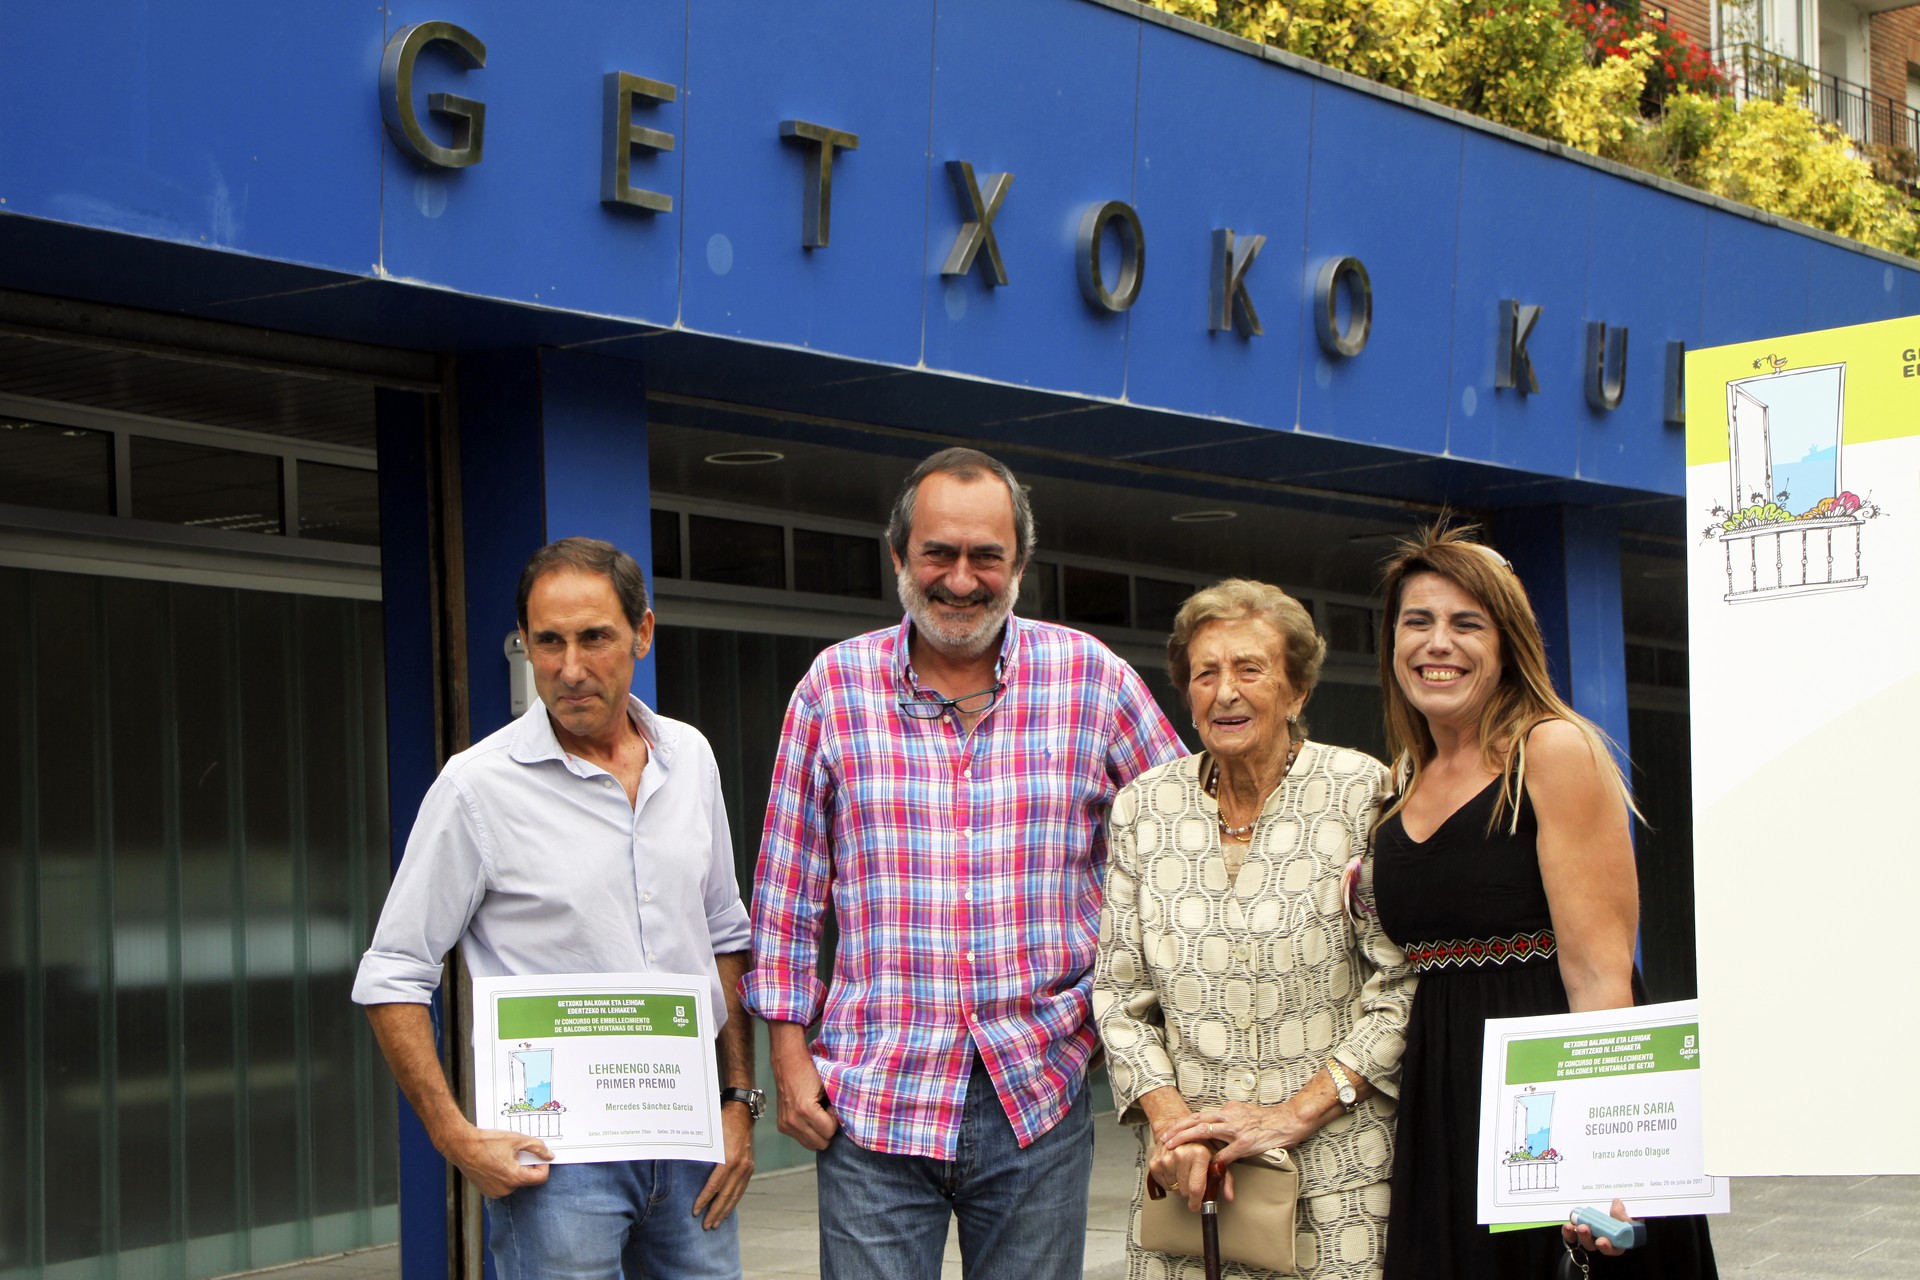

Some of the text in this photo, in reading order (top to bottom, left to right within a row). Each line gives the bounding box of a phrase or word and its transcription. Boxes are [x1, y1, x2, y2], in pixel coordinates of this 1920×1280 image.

[379, 20, 1372, 357] GETXOKO
[1902, 348, 1920, 362] G
[1903, 363, 1920, 378] E
[1564, 1059, 1592, 1067] CONCURSO
[1602, 1053, 1653, 1064] EMBELLECIMIENTO
[588, 1063, 681, 1074] LEHENENGO SARIA
[1598, 1064, 1627, 1072] VENTANAS
[596, 1078, 676, 1089] PRIMER PREMIO
[606, 1102, 693, 1111] Mercedes Sánchez García
[1589, 1102, 1674, 1118] BIGARREN SARIA
[1585, 1118, 1677, 1136] SEGUNDO PREMIO
[1592, 1147, 1670, 1159] Iranzu Arondo Olague
